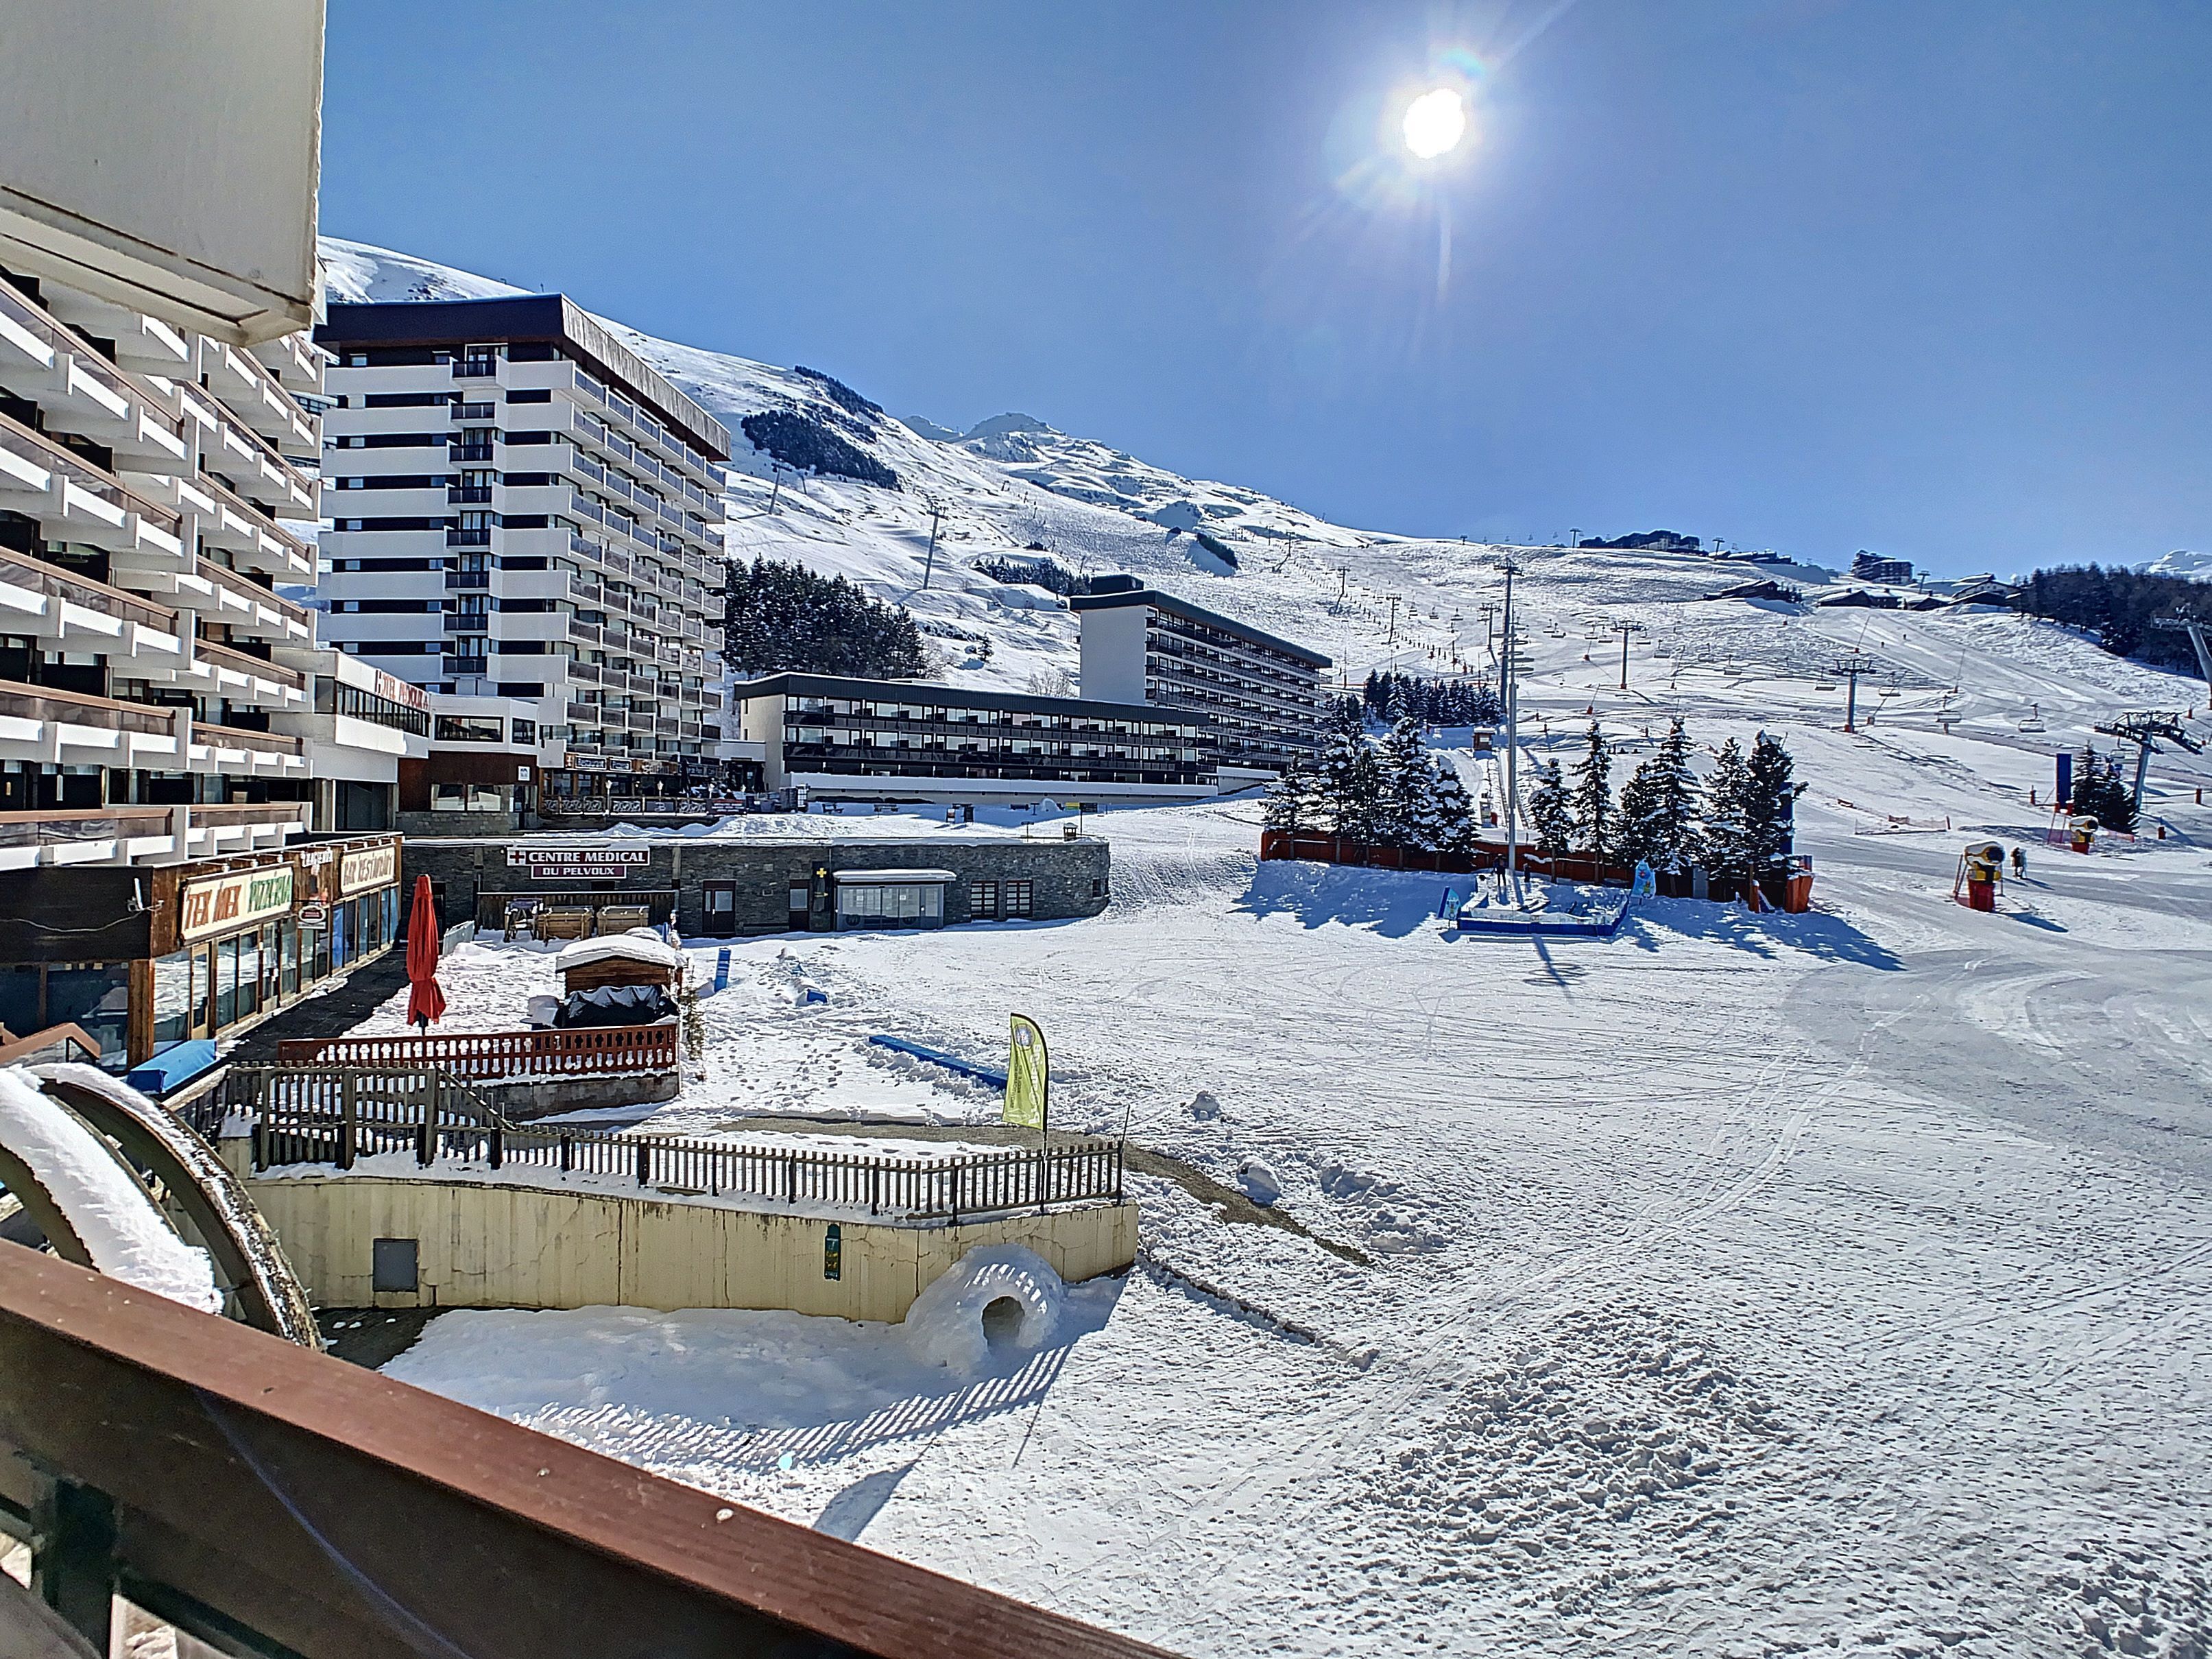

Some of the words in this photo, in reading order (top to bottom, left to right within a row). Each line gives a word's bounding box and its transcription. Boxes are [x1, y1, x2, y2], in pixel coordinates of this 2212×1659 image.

[529, 852, 580, 862] CENTRE
[584, 852, 645, 862] MEDICAL
[344, 861, 357, 886] BAR
[184, 890, 213, 931] TEX
[213, 885, 242, 923] MEX
[248, 875, 291, 913] PIZZERIA
